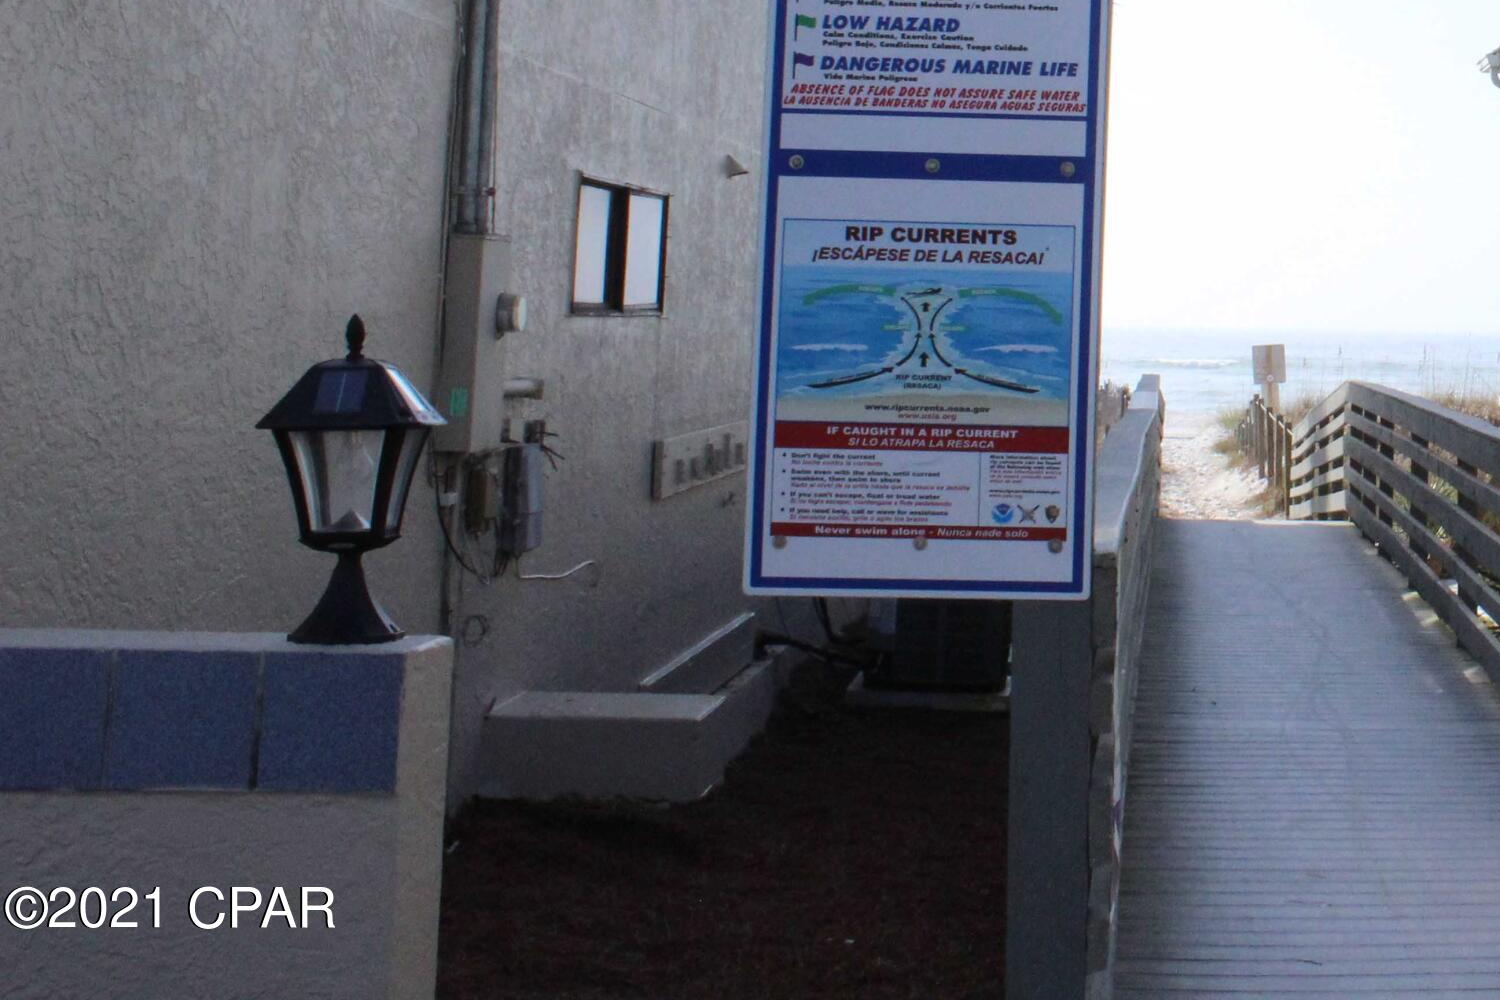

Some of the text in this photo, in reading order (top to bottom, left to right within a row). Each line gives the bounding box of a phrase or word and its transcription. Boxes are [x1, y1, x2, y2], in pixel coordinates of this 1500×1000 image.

[822, 15, 960, 32] LOW HAZARD
[820, 56, 1078, 77] DANGEROUS MARINE LIFE
[791, 84, 1079, 101] ABSENCE OF FLAG DOES NOT ASSURE SAFE WATER
[783, 96, 1086, 112] LA AUSENCIA DE BANDERAS NO ASEGURA AGUAS SEGURAS
[845, 226, 1017, 245] RIP CURRENTS
[914, 250, 938, 262] DE
[942, 251, 964, 263] LA
[969, 251, 1044, 265] RESACA!
[904, 382, 941, 390] (RESACA)
[827, 427, 1017, 438] IF CAUGHT IN A RIP CURRENT
[848, 438, 994, 449] SI LO ATRAPA LA RESACA
[815, 526, 1028, 538] Never swim alone Nunca nade solo
